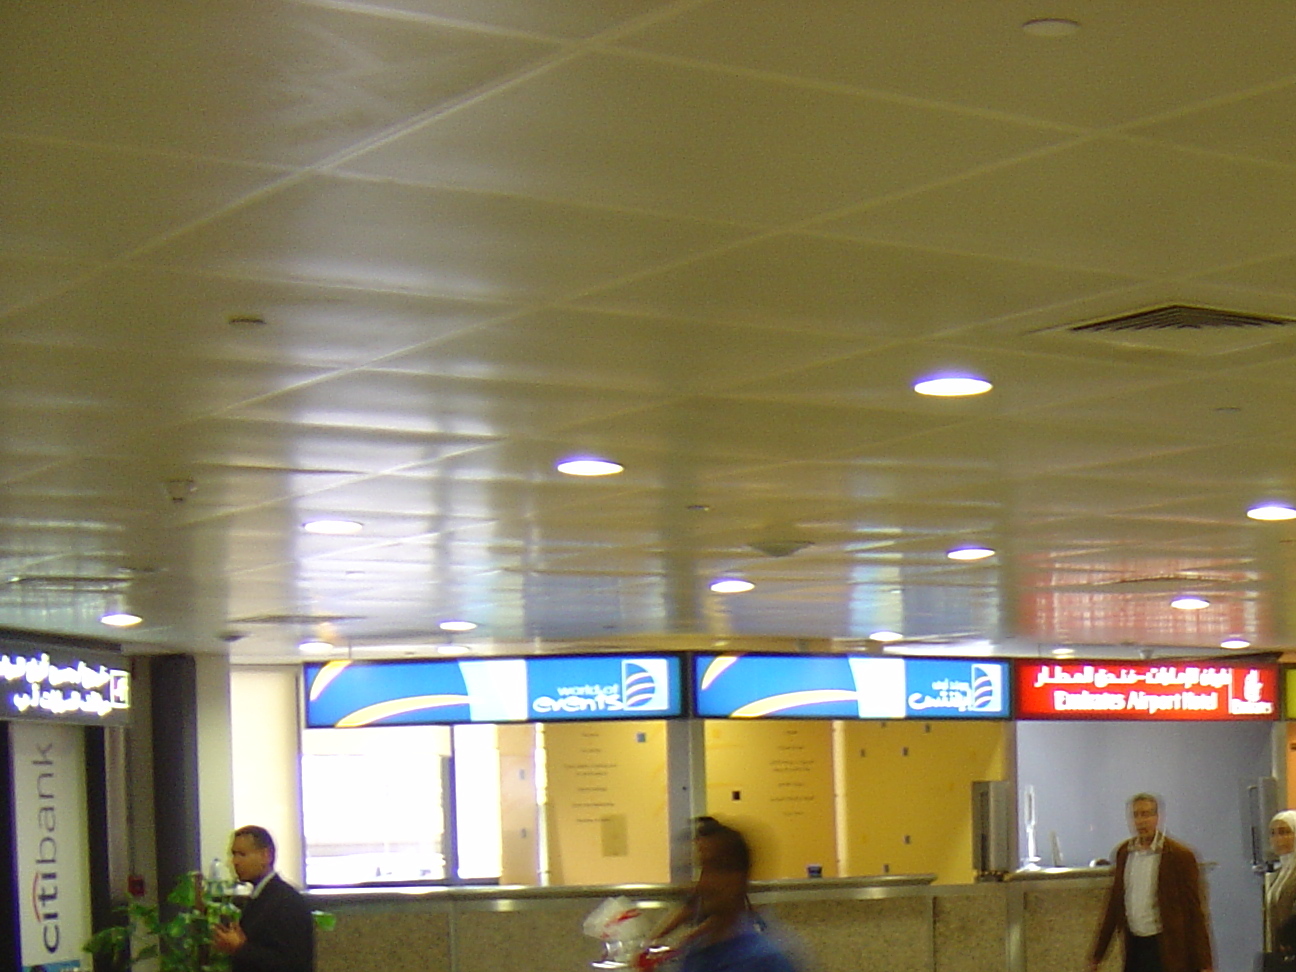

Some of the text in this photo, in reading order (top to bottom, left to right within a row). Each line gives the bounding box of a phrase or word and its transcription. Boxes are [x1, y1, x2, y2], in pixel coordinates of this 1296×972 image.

[557, 683, 619, 696] world of
[532, 694, 624, 713] events
[1126, 690, 1181, 714] Airport
[32, 741, 60, 954] citibank
